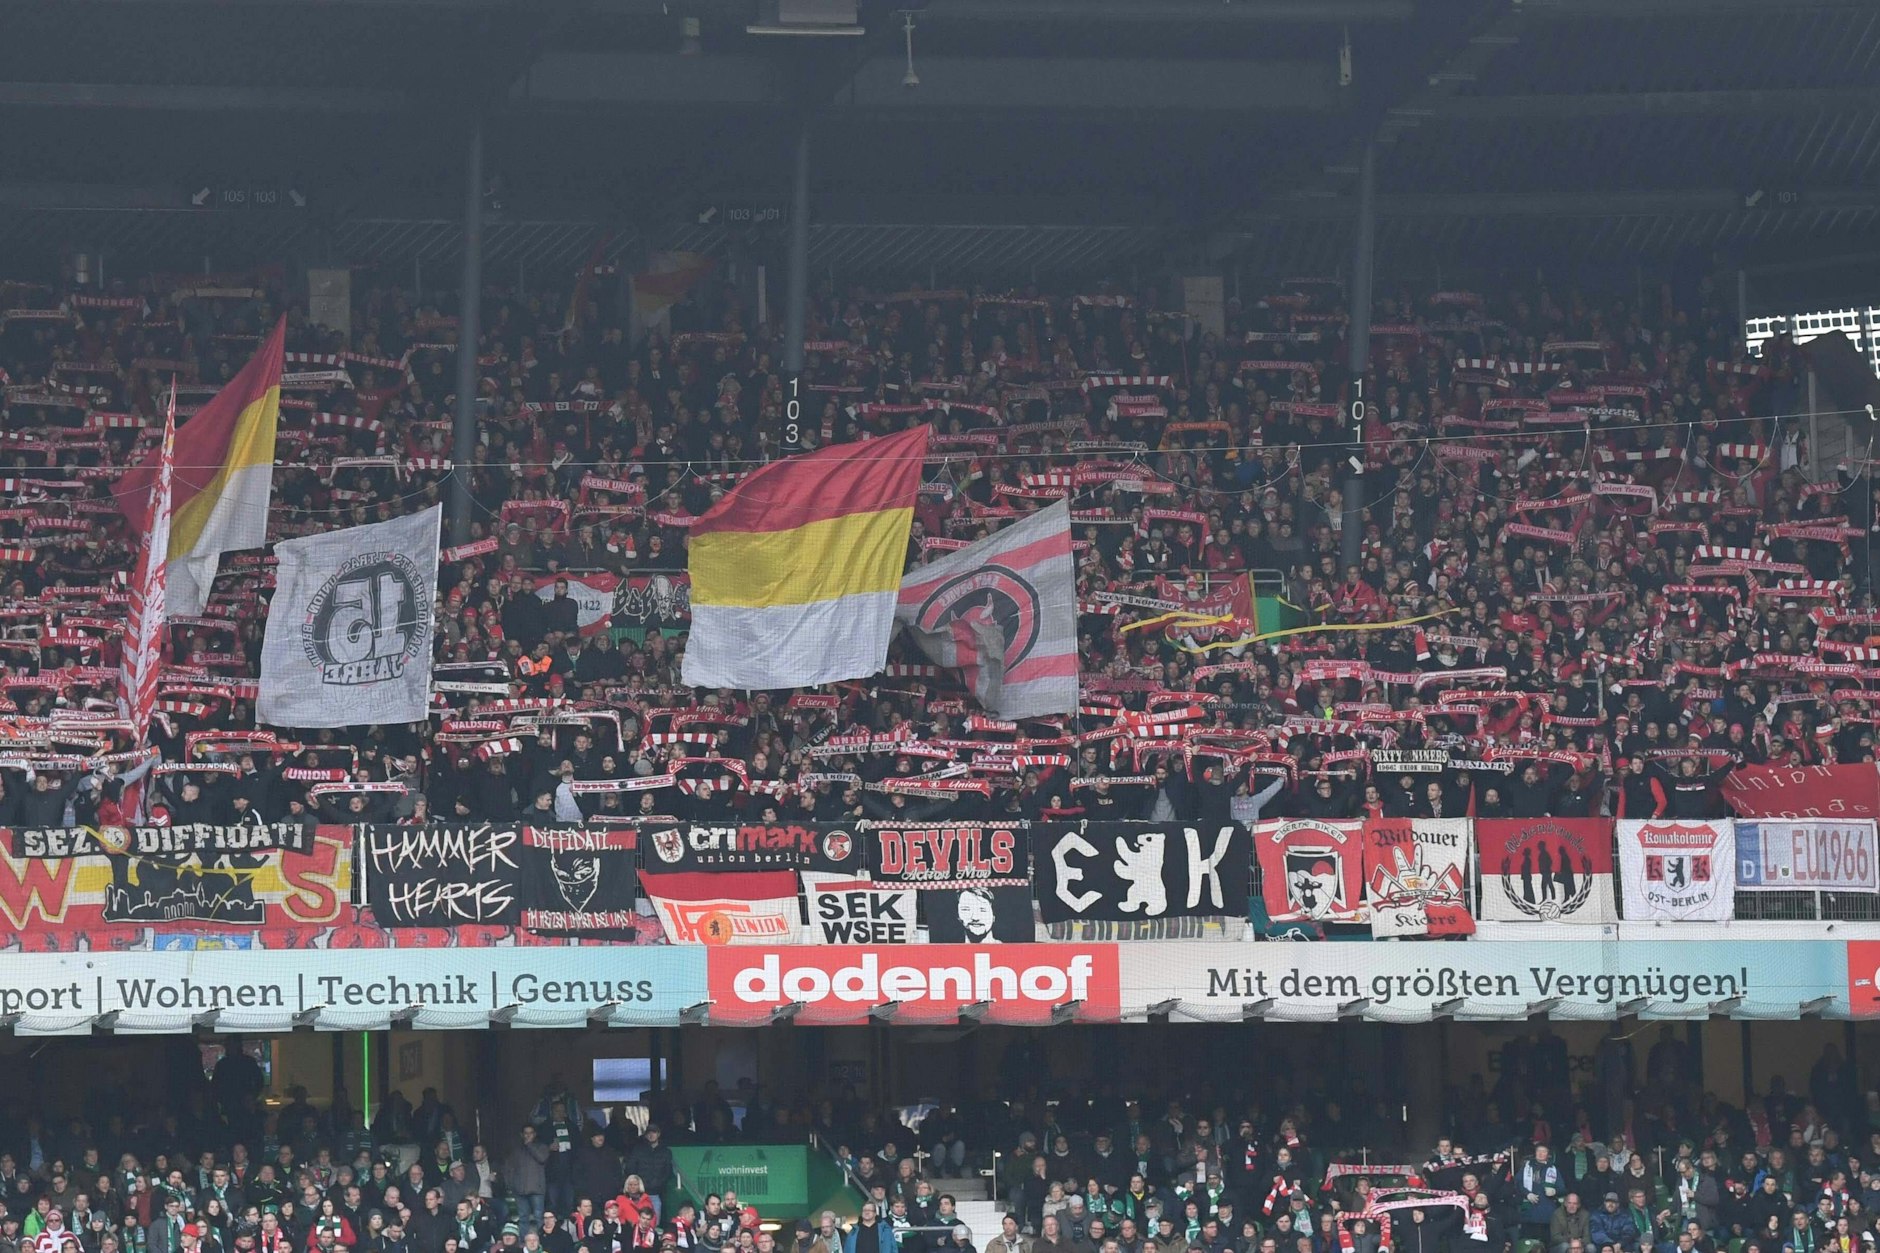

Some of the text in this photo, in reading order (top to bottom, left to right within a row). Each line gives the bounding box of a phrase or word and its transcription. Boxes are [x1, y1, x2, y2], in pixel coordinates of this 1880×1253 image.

[223, 191, 275, 203] 105 103
[1777, 192, 1797, 203] 101
[729, 208, 749, 220] 103
[785, 377, 799, 443] 103
[1351, 378, 1365, 443] 101
[8, 676, 62, 685] WALDSEITE
[797, 697, 829, 707] Eisern
[449, 721, 503, 731] WALDSEITE
[1086, 727, 1121, 740] Union
[1372, 749, 1449, 764] SIXTY NINERS
[1490, 747, 1578, 762] Eisern Union
[288, 767, 331, 780] UNION
[886, 779, 983, 789] Eisern Union
[1726, 764, 1833, 791] Union
[24, 823, 304, 857] SEZ. DIFFIDATI
[690, 825, 820, 855] crimark
[1314, 821, 1344, 842] BIKER
[1371, 827, 1458, 849] Wildauer
[370, 825, 519, 874] HAMMER
[697, 852, 811, 865] union berlin
[879, 827, 1015, 875] DEVILS
[1050, 825, 1235, 914] E K
[1742, 860, 1755, 880] D
[388, 877, 516, 923] HEARTS
[818, 892, 905, 922] SEK
[1647, 892, 1710, 908] OST-BERLIN
[734, 914, 788, 936] UNION
[822, 922, 906, 944] WSEE
[733, 952, 1092, 1004] dodenhof
[1207, 966, 1748, 1004] Mit dem größten Vergnügen!
[1, 974, 654, 1012] port Wohnen Technik Genuss
[718, 1165, 768, 1175] wohninvest
